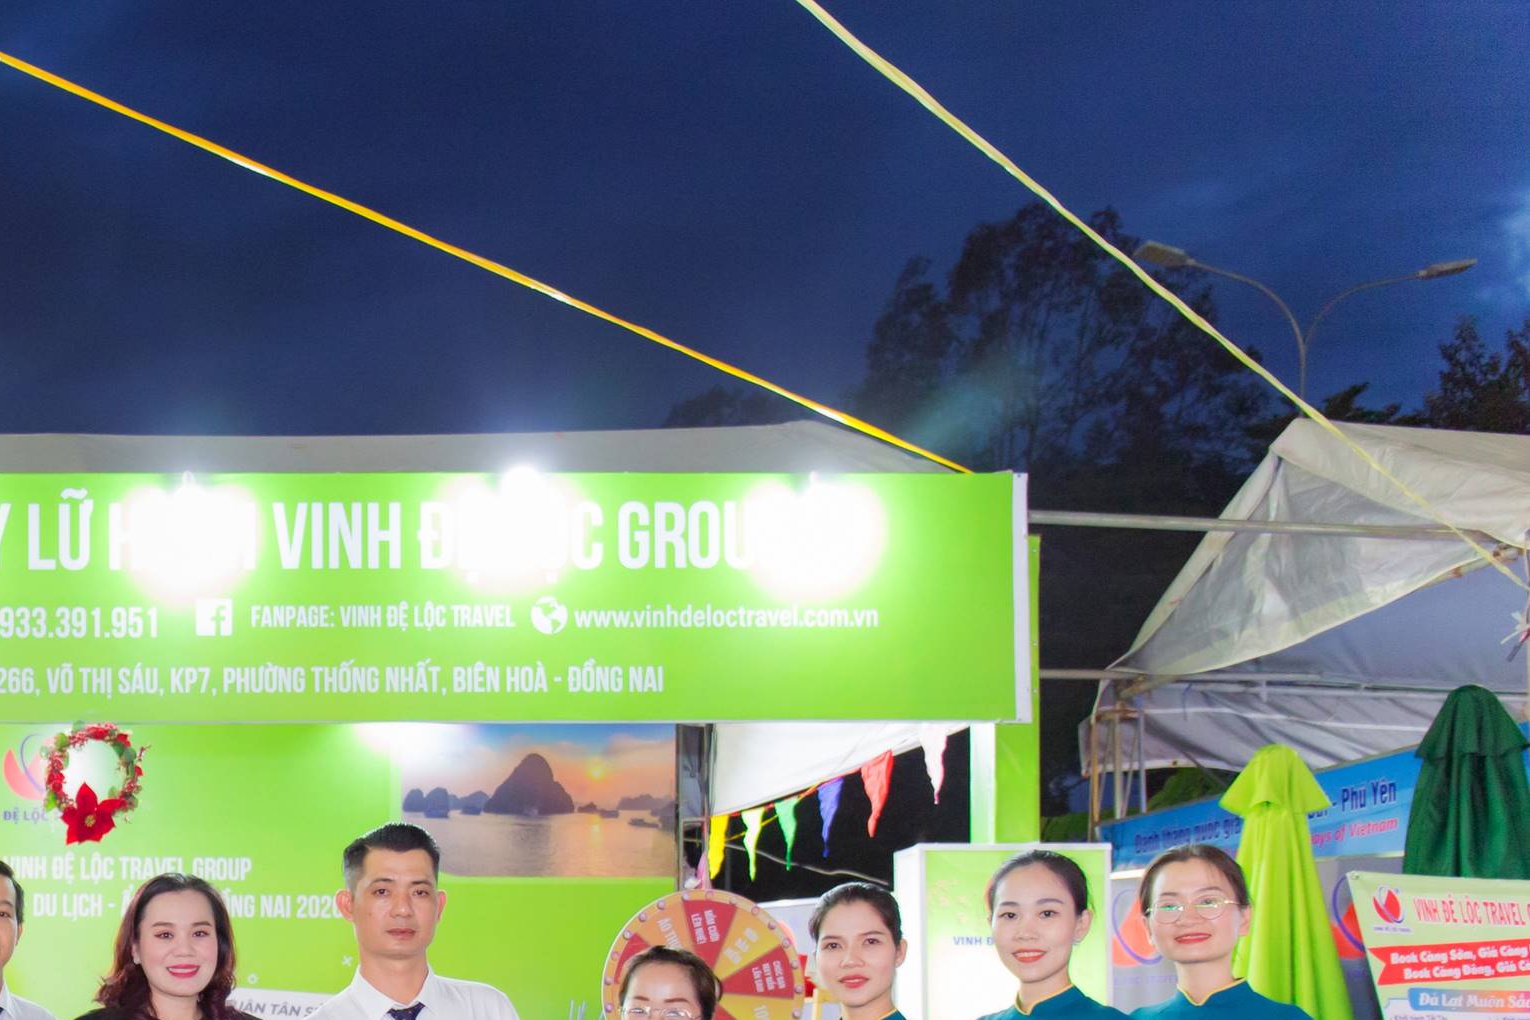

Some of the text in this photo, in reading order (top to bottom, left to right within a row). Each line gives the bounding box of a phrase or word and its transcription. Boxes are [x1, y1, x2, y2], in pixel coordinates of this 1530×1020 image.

[28, 488, 94, 571] LỮ
[273, 503, 401, 569] VINH
[251, 601, 514, 634] FANPAGE: VINH ĐỆ LỘC TRAVEL
[574, 603, 877, 629] www.vinhdeloctravel.com.vn
[47, 663, 75, 694] VÕ
[79, 667, 113, 699] THỊ
[118, 663, 164, 698] SÁU,
[170, 667, 217, 698] KP7,
[223, 659, 304, 694] PHƯỜNG
[311, 658, 379, 693] THỐNG
[386, 658, 447, 697] NHẤT,
[452, 660, 500, 694] BIÊN
[506, 660, 548, 693] HOÀ
[567, 658, 622, 694] ĐỒNG
[629, 666, 664, 693] NAI
[1342, 778, 1397, 812] Phú Yên
[3, 808, 20, 824] ĐỆ
[1334, 818, 1398, 841] of Vietnam
[52, 852, 252, 884] ĐỆ LỘC TRAVEL GROUP
[33, 894, 102, 922] DU LỊCH
[261, 895, 291, 917] NAI
[1413, 894, 1526, 925] VINH ĐỆ LỘC TRAVEL
